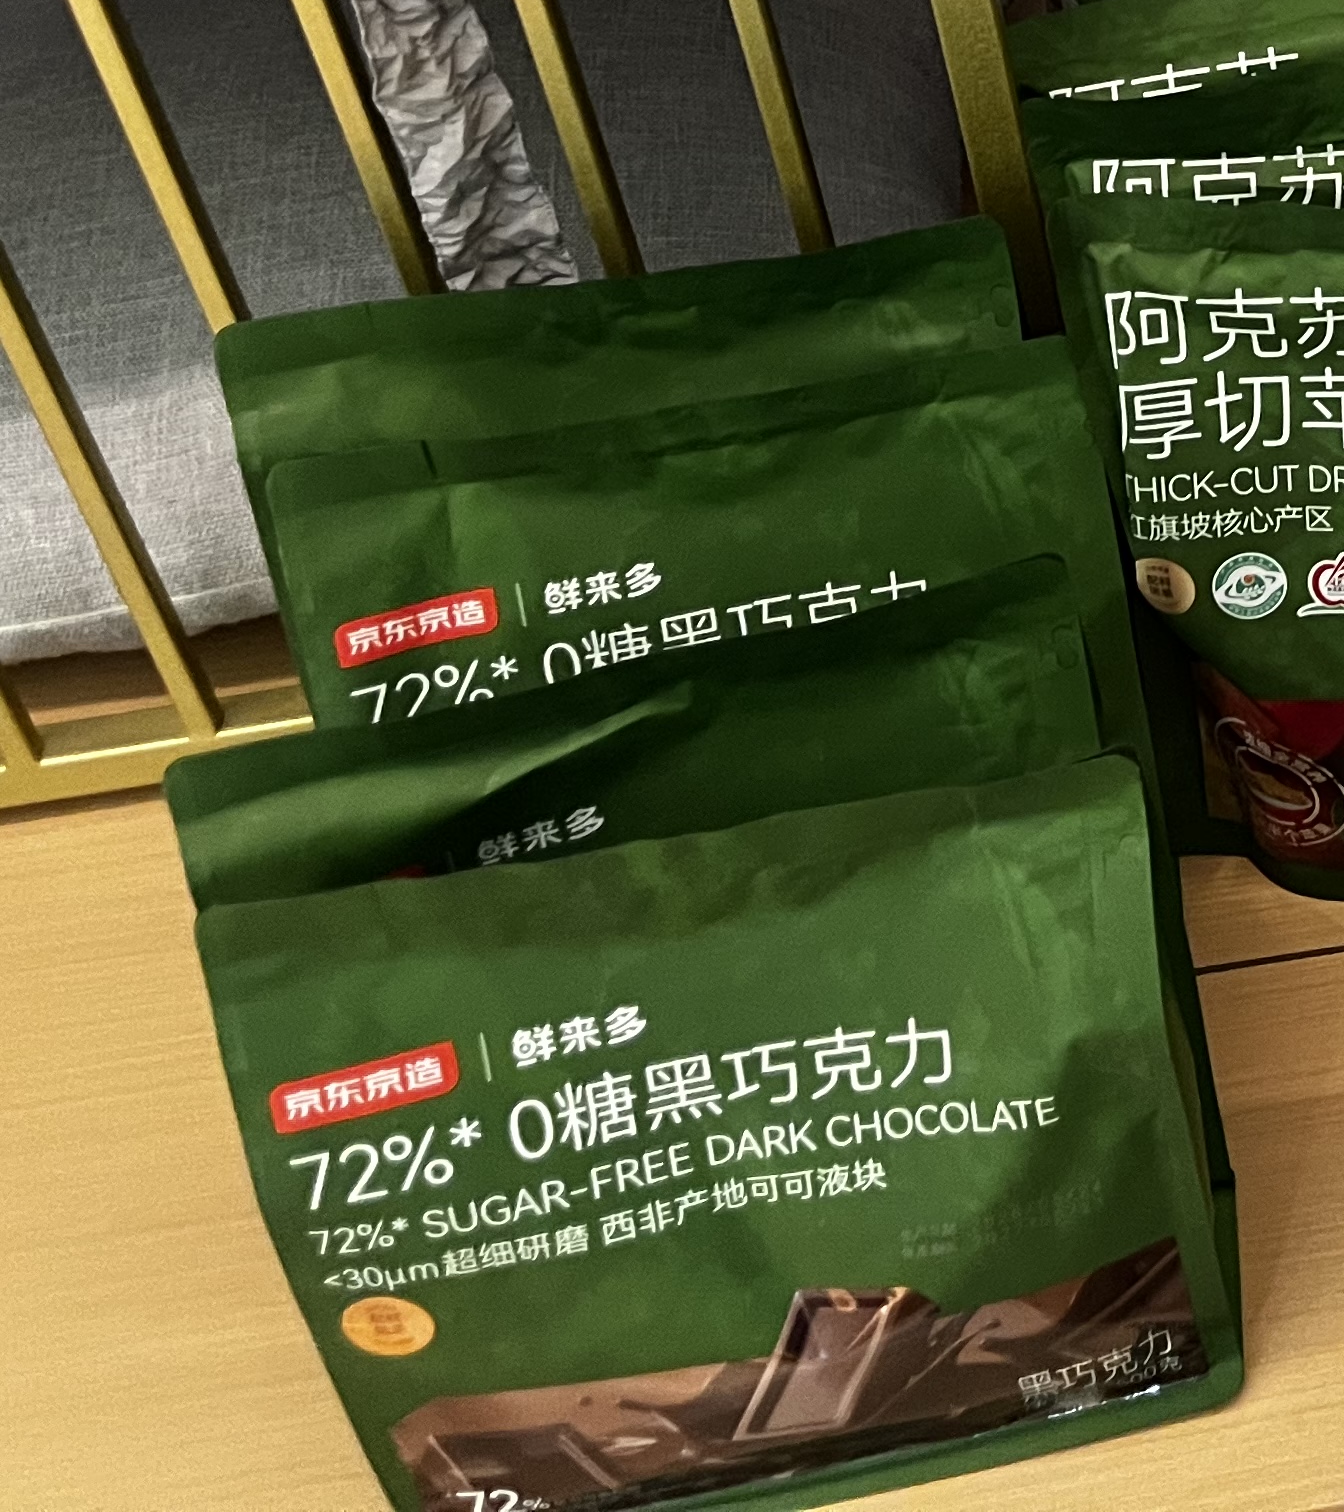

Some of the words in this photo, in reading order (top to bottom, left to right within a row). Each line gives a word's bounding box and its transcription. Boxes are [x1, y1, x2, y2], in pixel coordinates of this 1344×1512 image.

[346, 596, 486, 657] 京东京造
[543, 560, 664, 616] 鲜来多
[478, 803, 606, 870] 鲜来多
[283, 1055, 445, 1121] 京东京造
[511, 1004, 649, 1070] 鲜来多
[508, 1016, 956, 1162] 0糖黑巧克力
[422, 1145, 696, 1242] SUGAR-FREE
[705, 1121, 820, 1169] DARK
[825, 1094, 1062, 1149] CHOCOLATE
[602, 1158, 889, 1249] 西非产地可可液块
[1018, 1328, 1173, 1410] 黑巧克力
